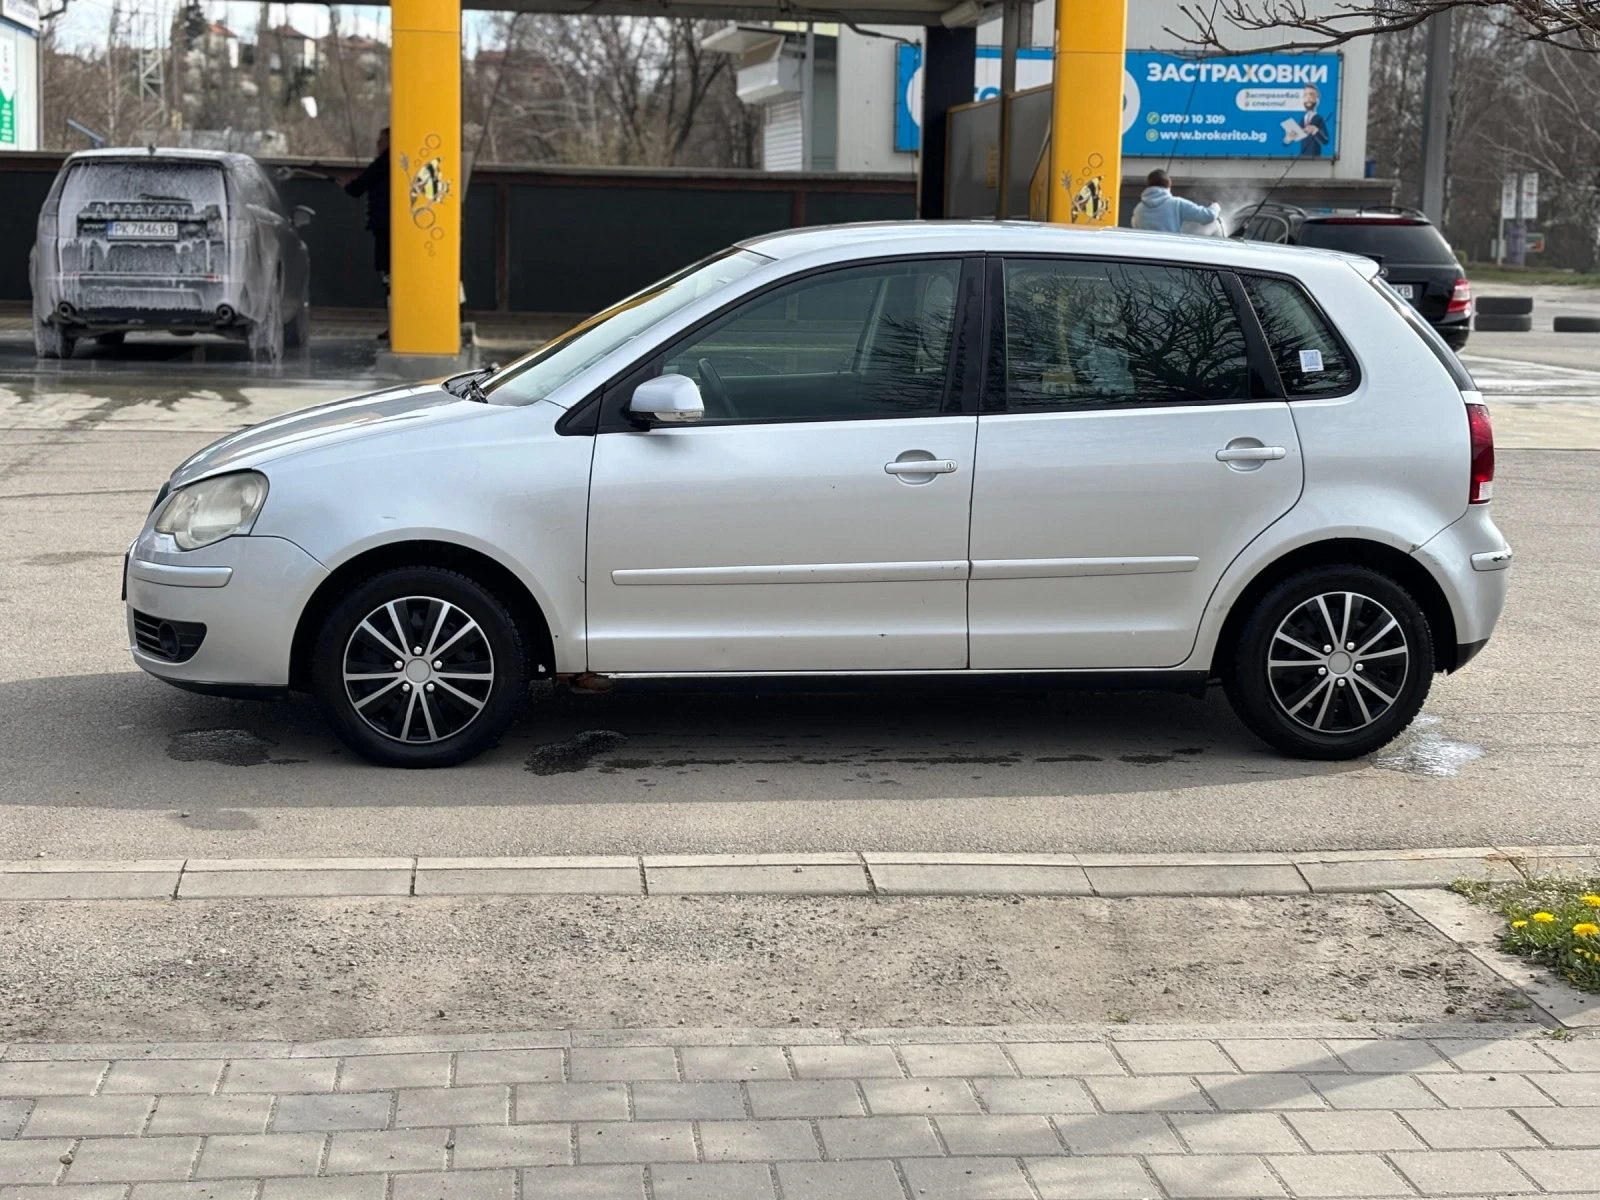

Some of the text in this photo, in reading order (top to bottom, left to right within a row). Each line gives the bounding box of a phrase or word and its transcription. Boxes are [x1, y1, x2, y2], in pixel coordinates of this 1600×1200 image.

[1147, 62, 1328, 83] ЗАСТРАХОВКИ
[1161, 114, 1226, 124] 0700 10 309
[1160, 129, 1267, 143] www.brokerito.bg
[132, 223, 159, 234] 7846
